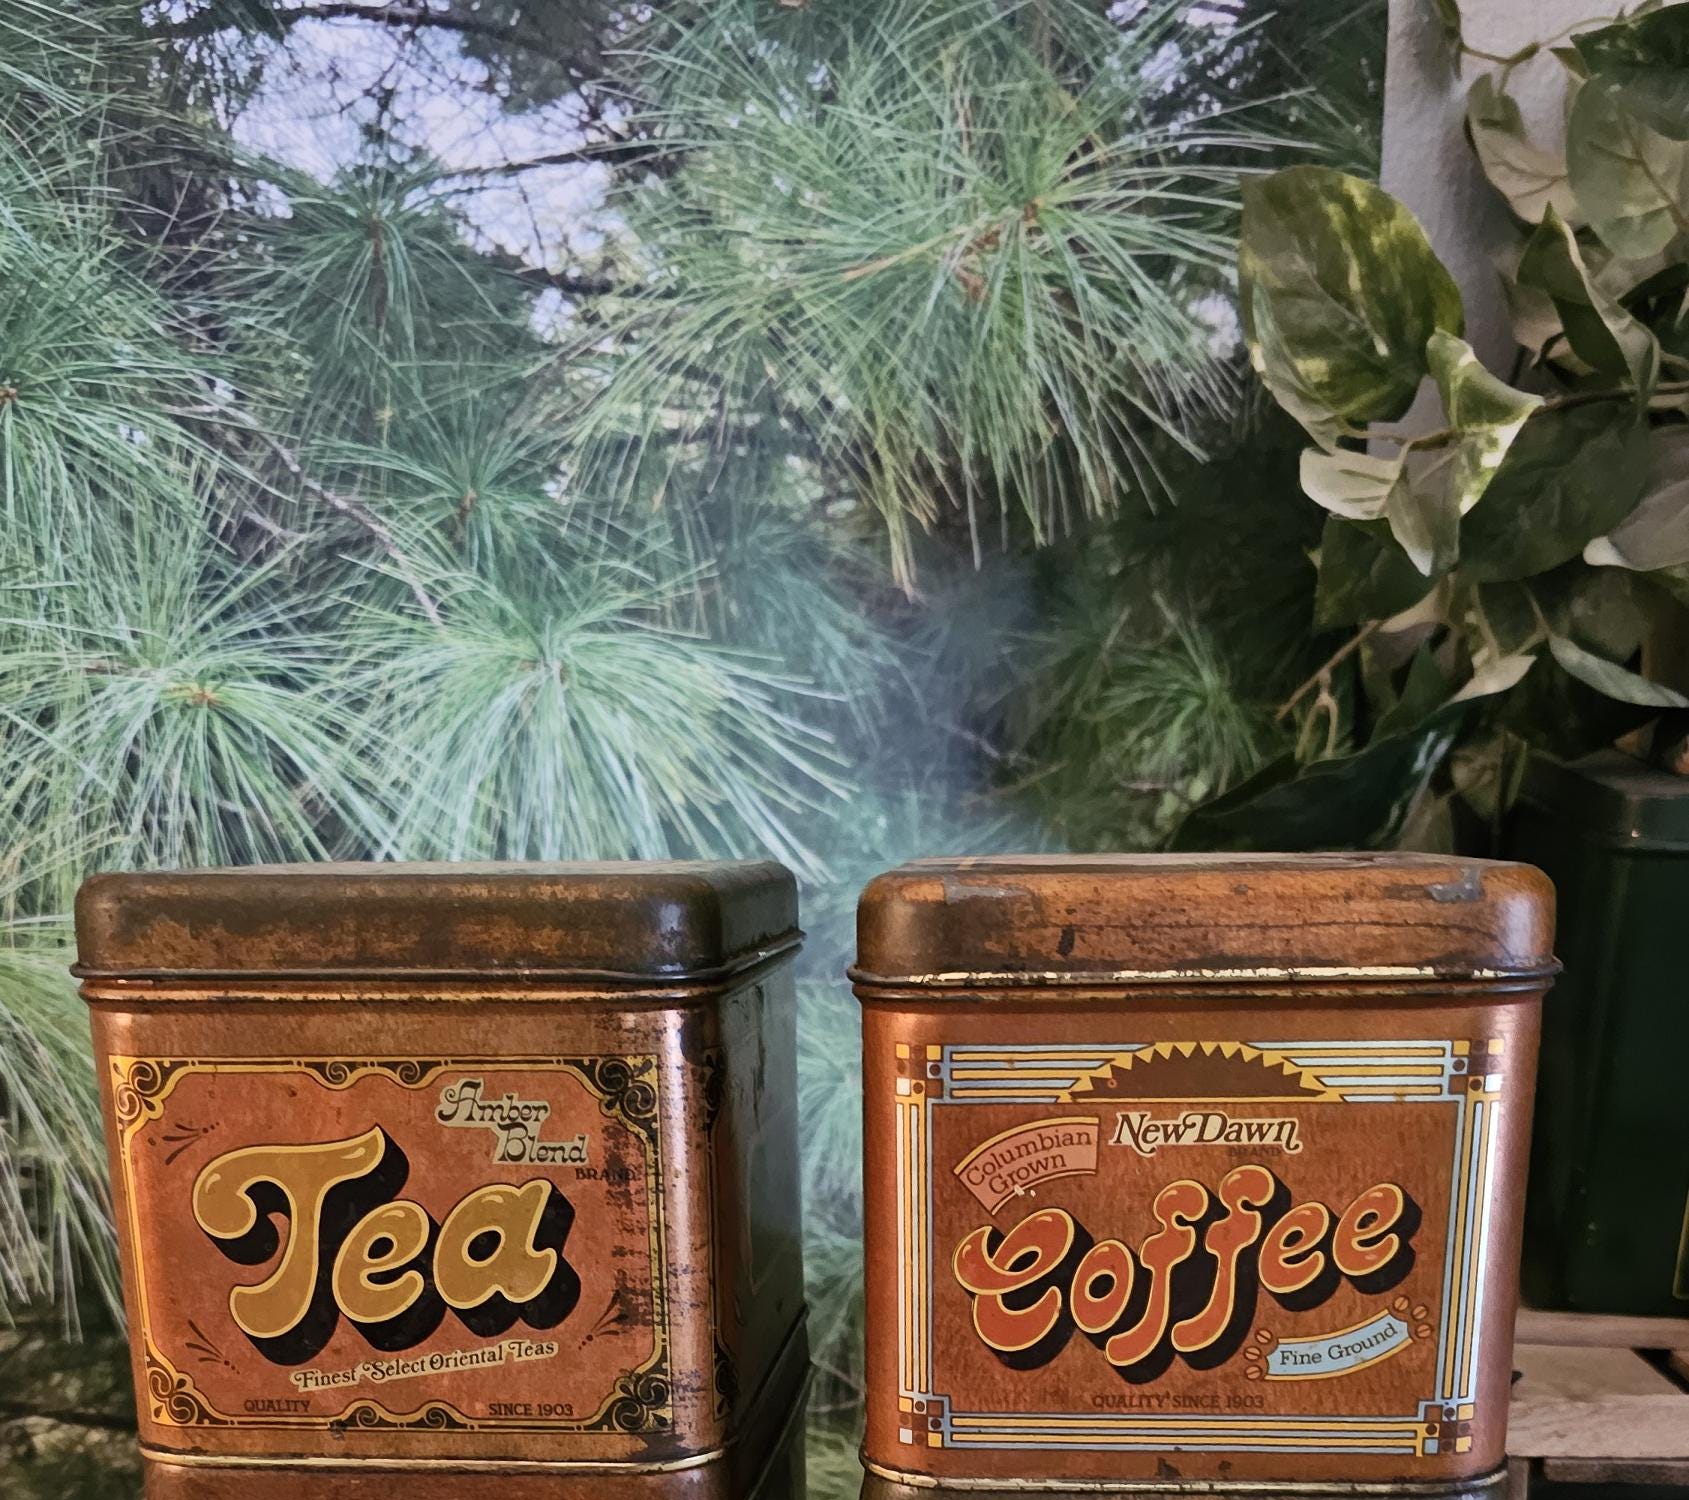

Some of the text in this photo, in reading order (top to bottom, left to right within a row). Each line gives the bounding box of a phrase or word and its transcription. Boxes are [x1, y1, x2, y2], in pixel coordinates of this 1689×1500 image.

[438, 1081, 548, 1122] Amber
[498, 1122, 586, 1163] Blend
[1113, 1112, 1300, 1154] New Dawn
[966, 1127, 1092, 1187] Columbian
[988, 1152, 1068, 1196] Grown
[192, 1124, 575, 1358] Tea
[953, 1165, 1418, 1380] Coffee
[293, 1341, 555, 1388] Finest Select Oriental Teas
[1279, 1322, 1400, 1366] Fine Ground
[244, 1399, 574, 1417] QUALITY SINCE 1903
[1172, 1393, 1220, 1409] SINCE
